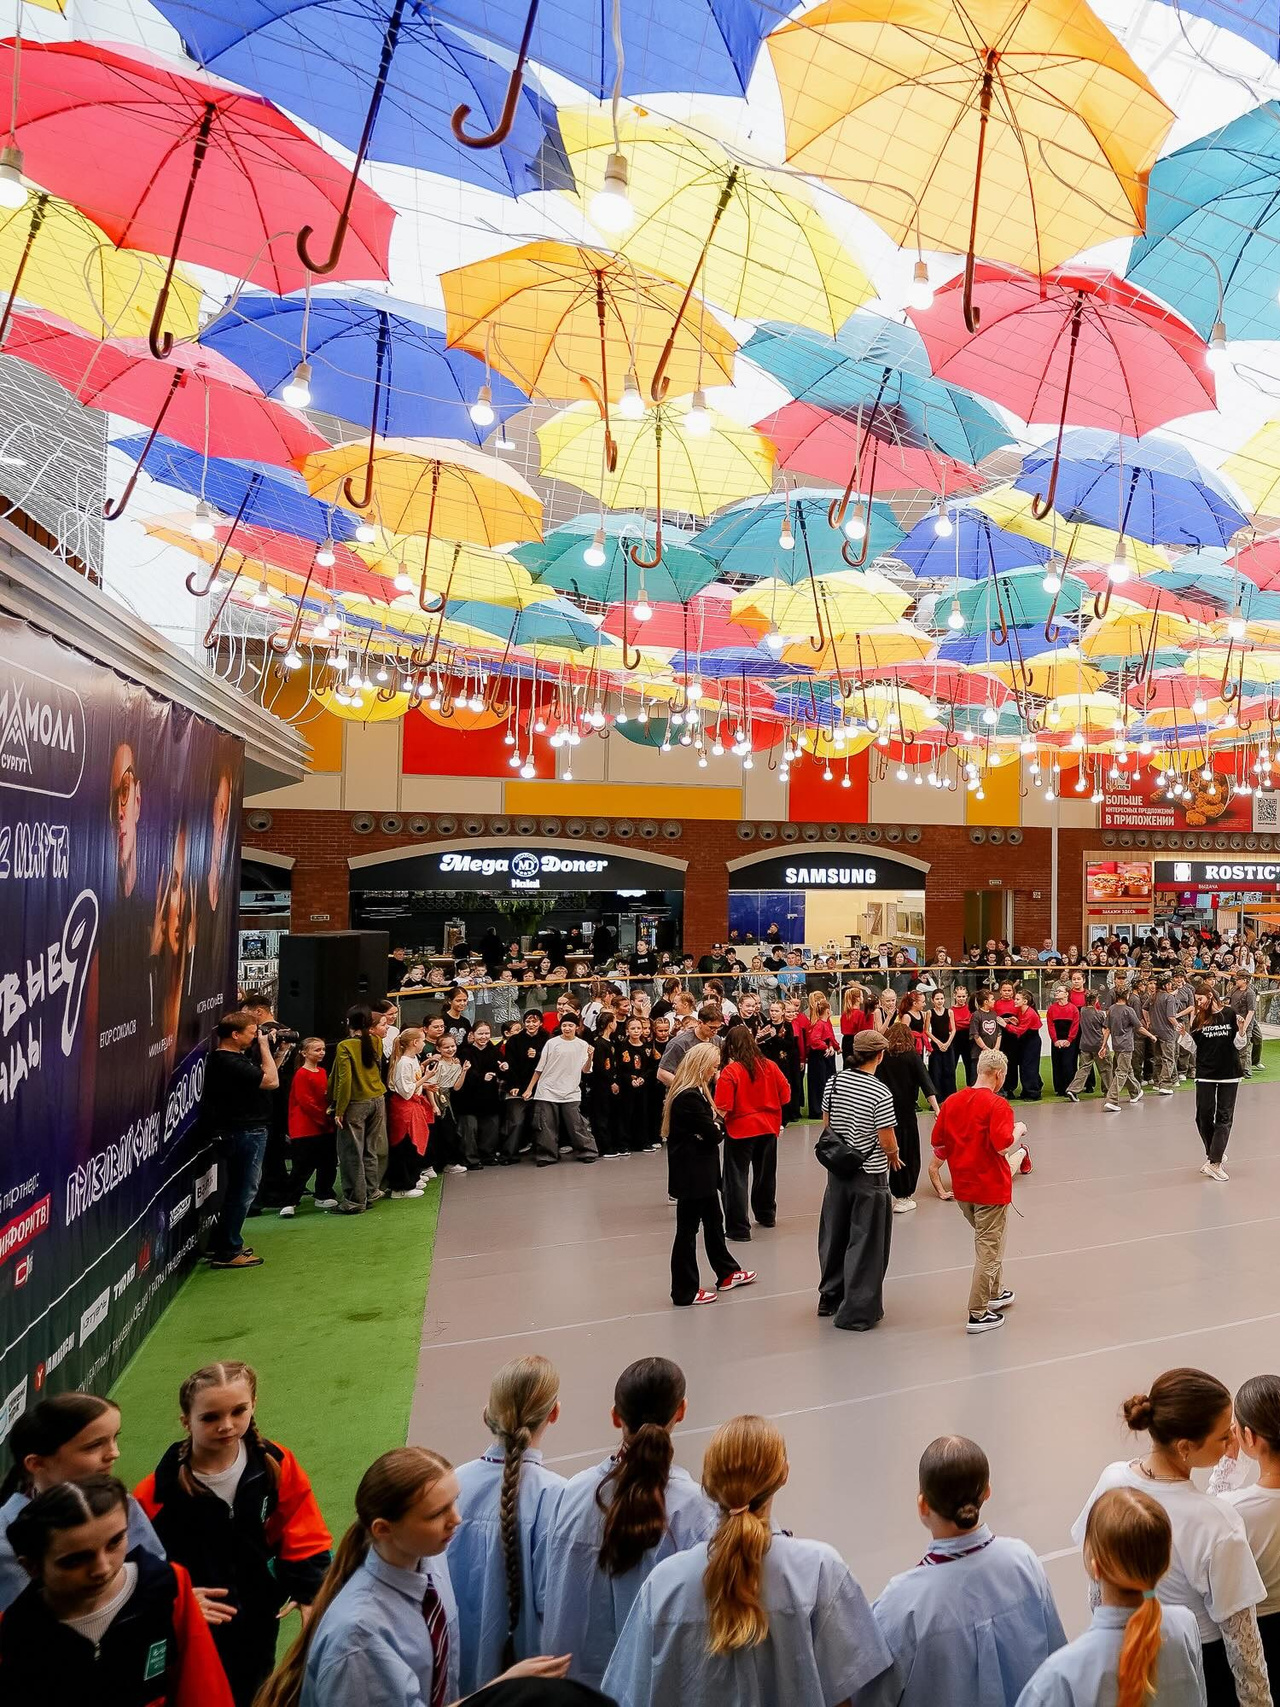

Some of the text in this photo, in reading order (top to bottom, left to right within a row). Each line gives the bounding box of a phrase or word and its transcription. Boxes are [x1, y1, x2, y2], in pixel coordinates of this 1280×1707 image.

[1, 753, 27, 773] СУРГУТ
[1105, 794, 1143, 806] БОЛЬШЕ
[1105, 806, 1174, 815] ИНТЕРЕСНЫХ ПРЕДЛОЖЕНИЙ
[1105, 814, 1175, 826] В ПРИЛОЖЕНИИ
[14, 821, 70, 879] МАРТА
[439, 854, 509, 876] Mega
[541, 855, 608, 872] Doner
[511, 879, 540, 889] Halal
[785, 867, 877, 884] SAMSUNG
[66, 1124, 134, 1227] ПРИЗОВОЙ
